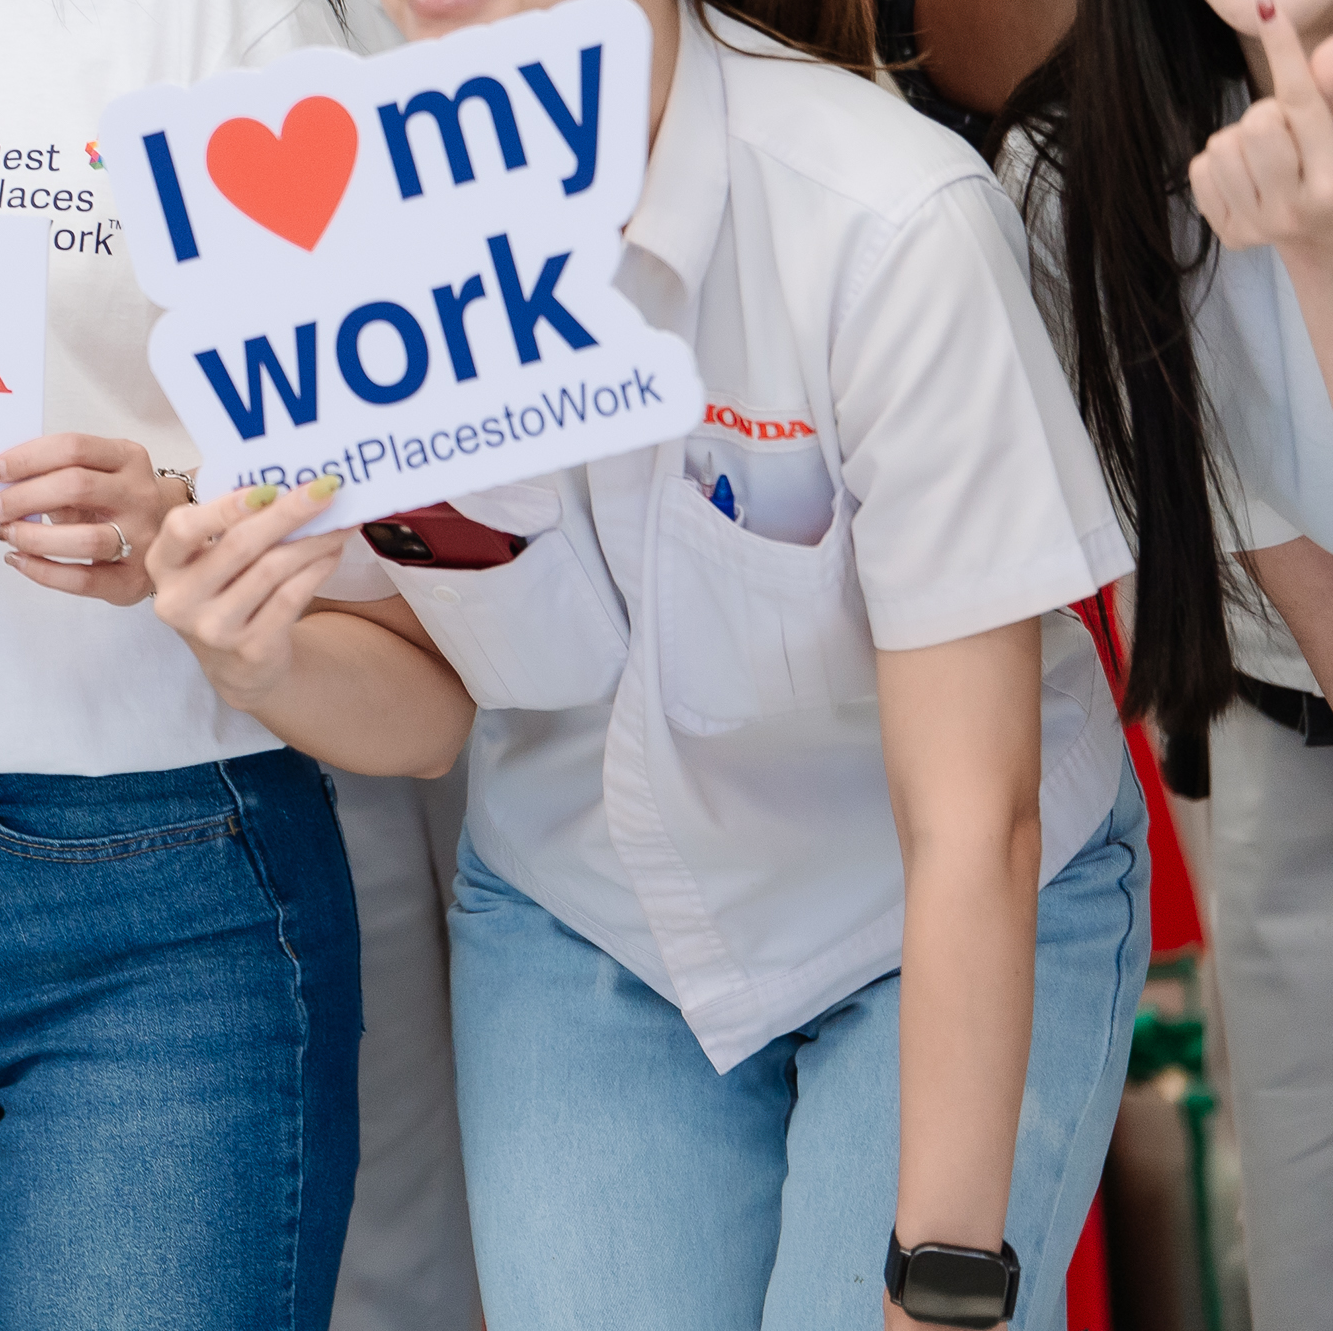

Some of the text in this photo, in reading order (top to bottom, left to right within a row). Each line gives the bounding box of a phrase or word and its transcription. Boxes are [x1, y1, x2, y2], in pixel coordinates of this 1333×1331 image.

[142, 43, 605, 263] I my
[193, 232, 599, 442] work
